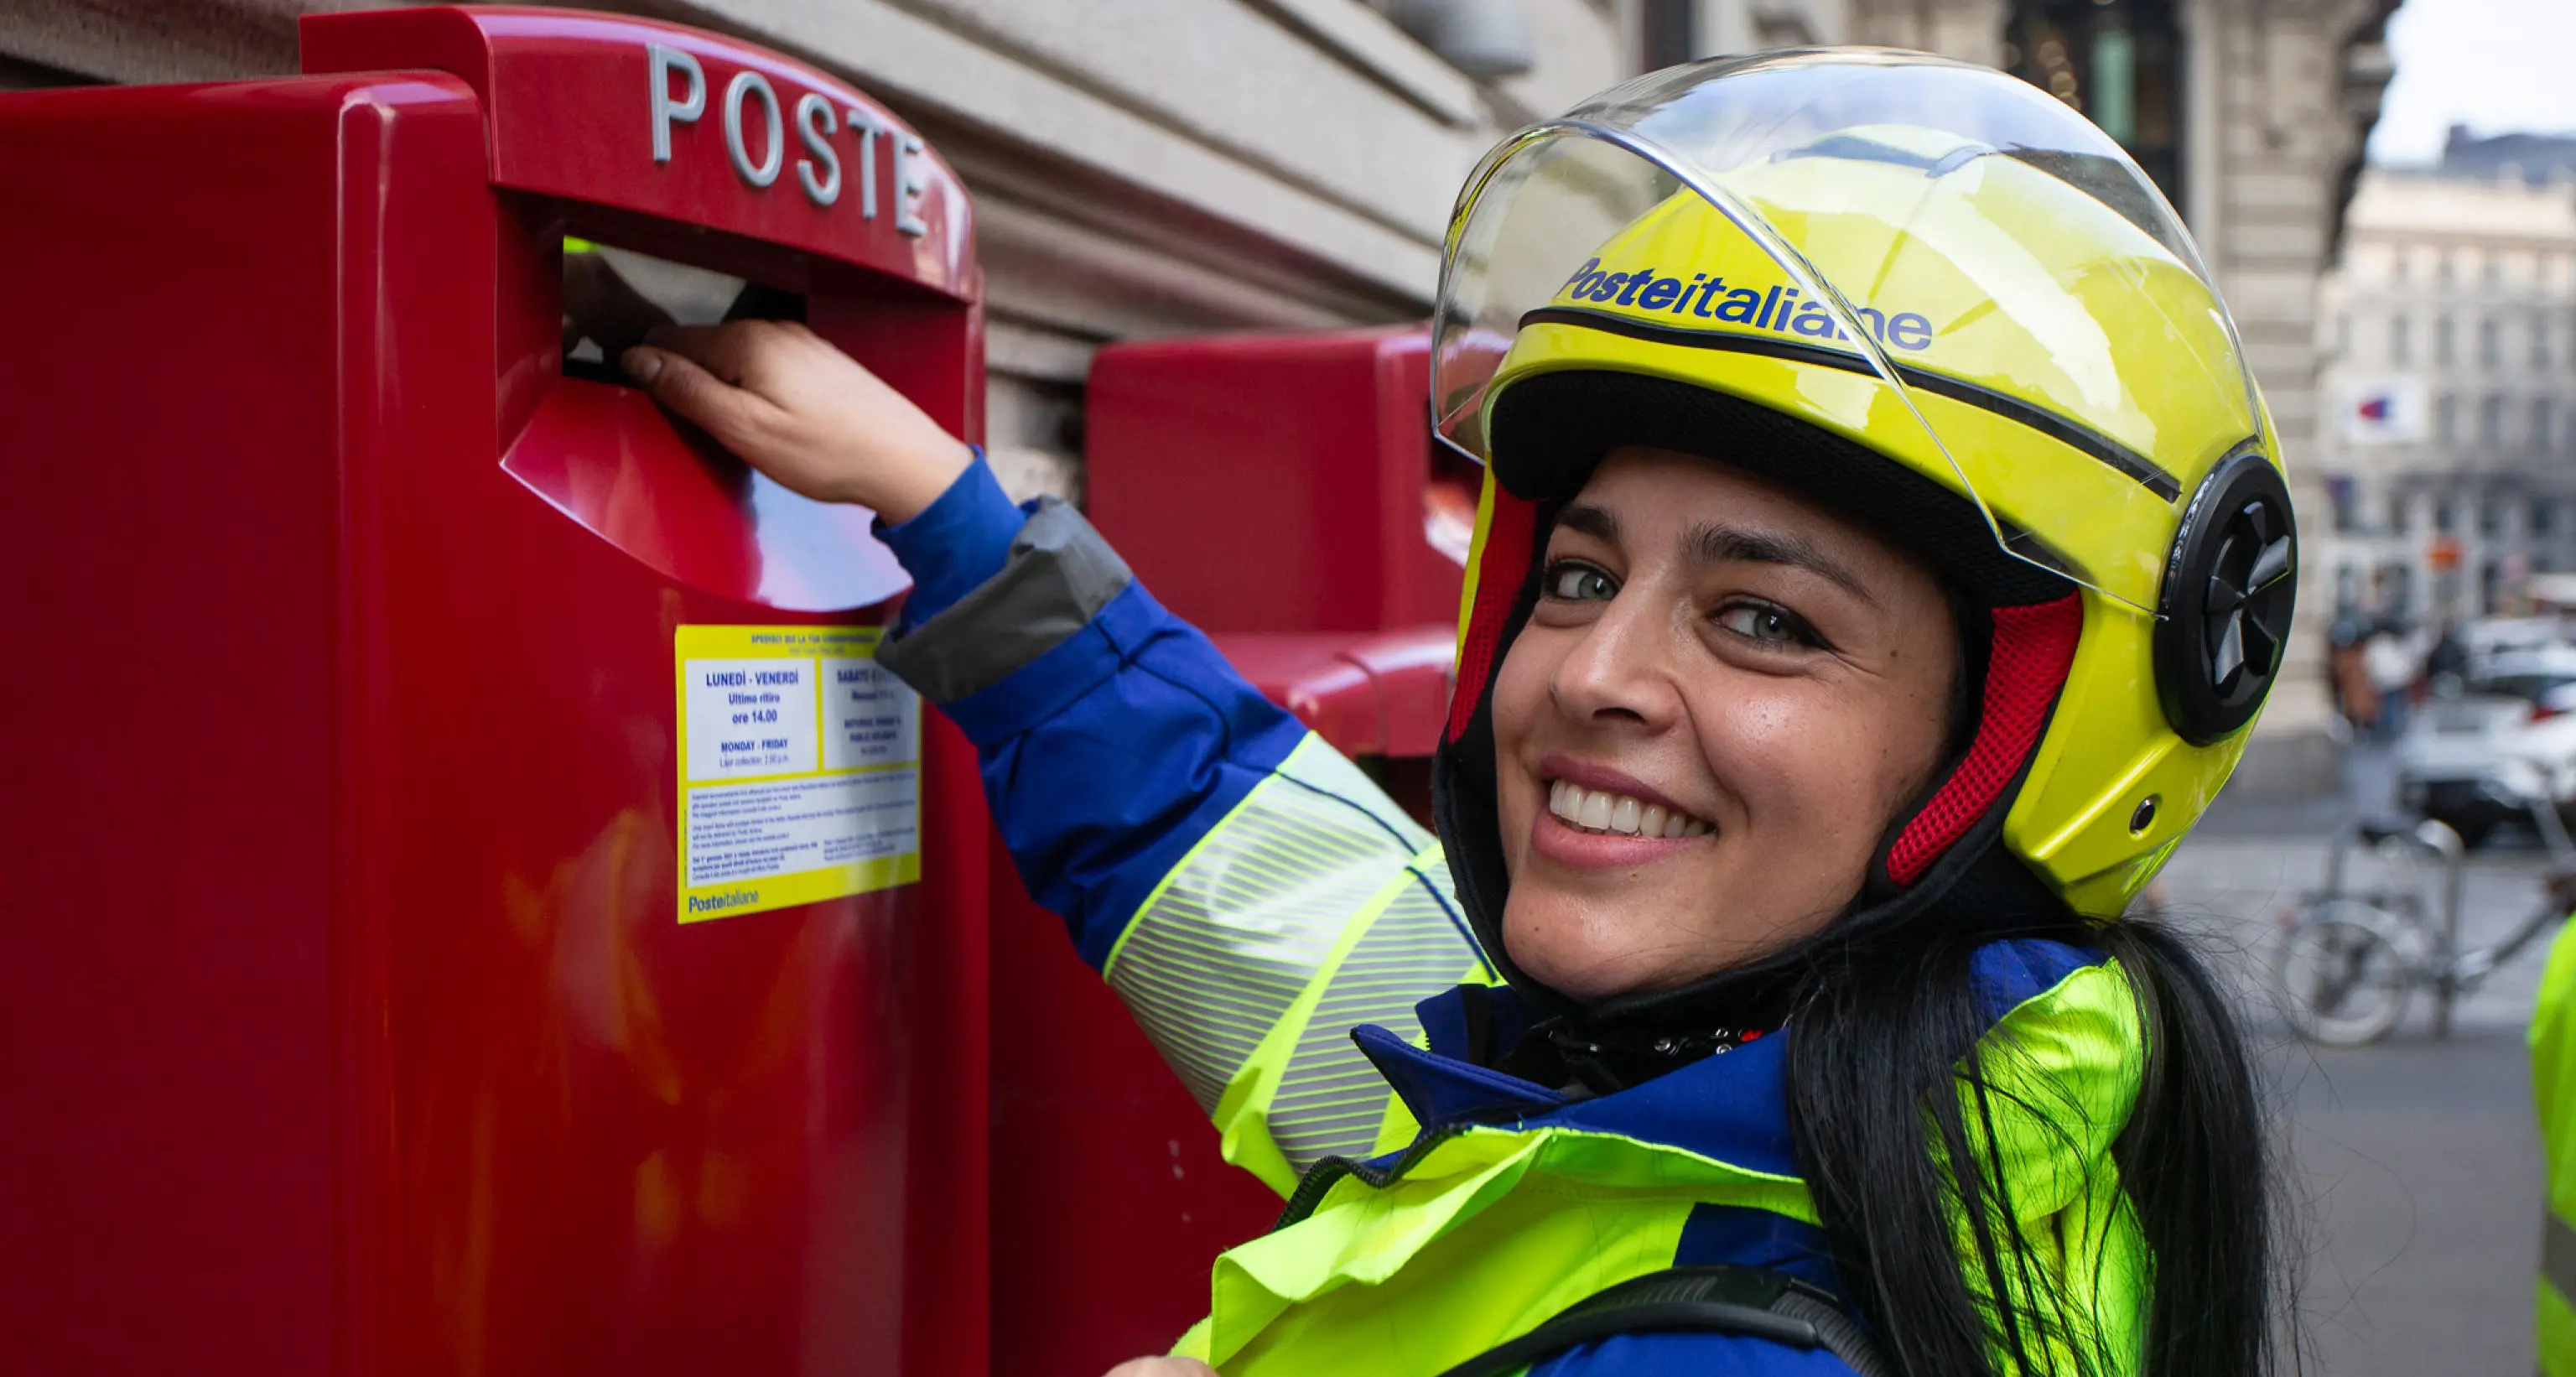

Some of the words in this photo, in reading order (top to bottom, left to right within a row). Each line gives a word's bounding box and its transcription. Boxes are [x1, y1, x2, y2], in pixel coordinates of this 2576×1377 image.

[647, 43, 927, 237] POSTE
[1555, 257, 1933, 351] Posteitaliane
[729, 693, 757, 705] Ultimo
[760, 692, 780, 704] ritiro
[732, 713, 749, 724] ore
[752, 709, 777, 723] 14.00
[721, 740, 755, 753] MONDAY
[761, 738, 788, 751] FRIDAY
[688, 889, 759, 913] Posteitaliane
